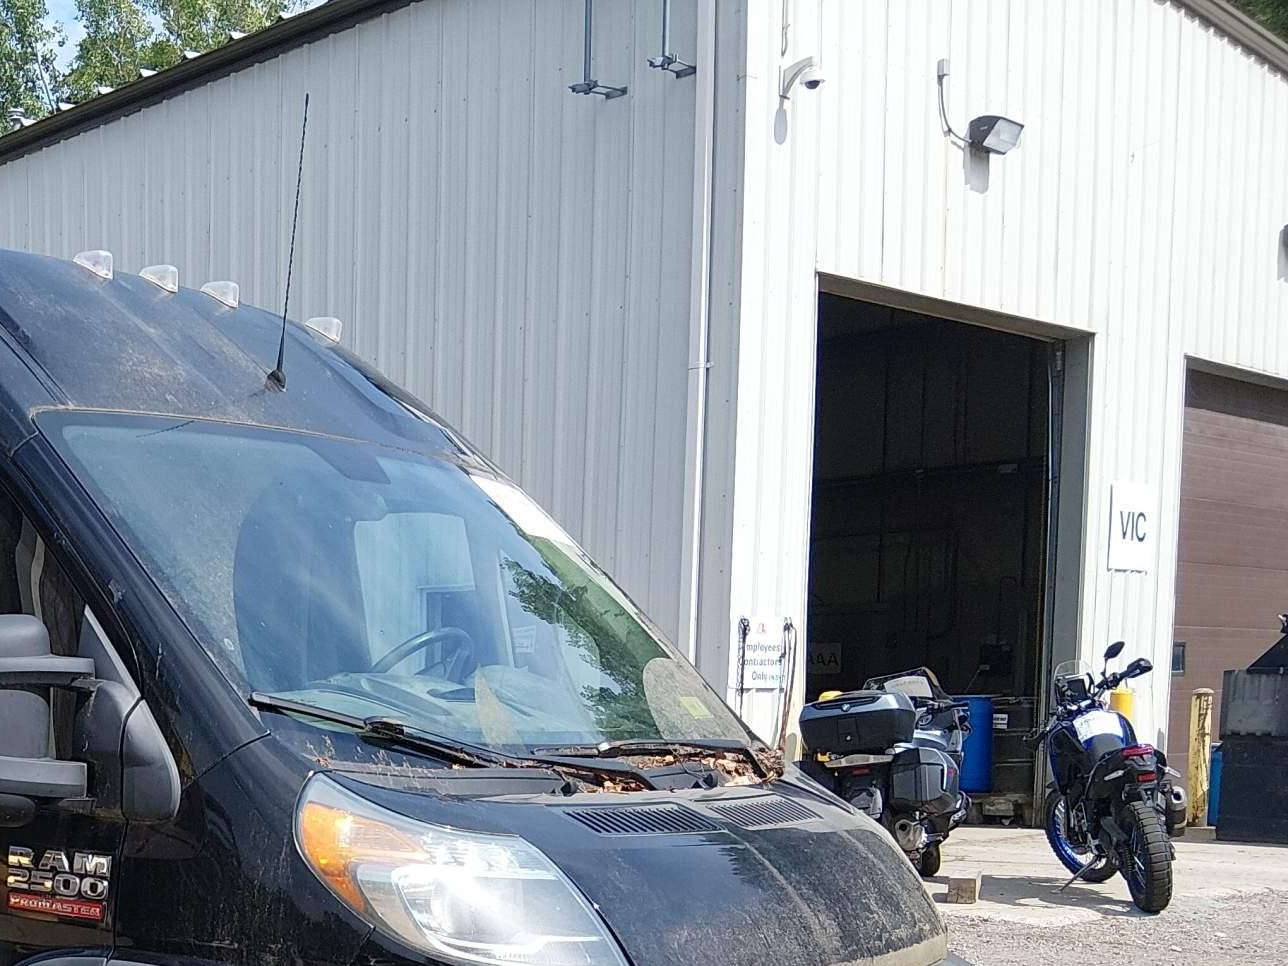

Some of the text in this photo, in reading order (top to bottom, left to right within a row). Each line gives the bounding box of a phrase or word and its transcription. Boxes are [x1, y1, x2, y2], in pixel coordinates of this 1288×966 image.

[1119, 510, 1147, 543] VIC
[745, 642, 781, 653] mployees
[7, 845, 112, 877] RAM
[7, 867, 109, 899] 2500
